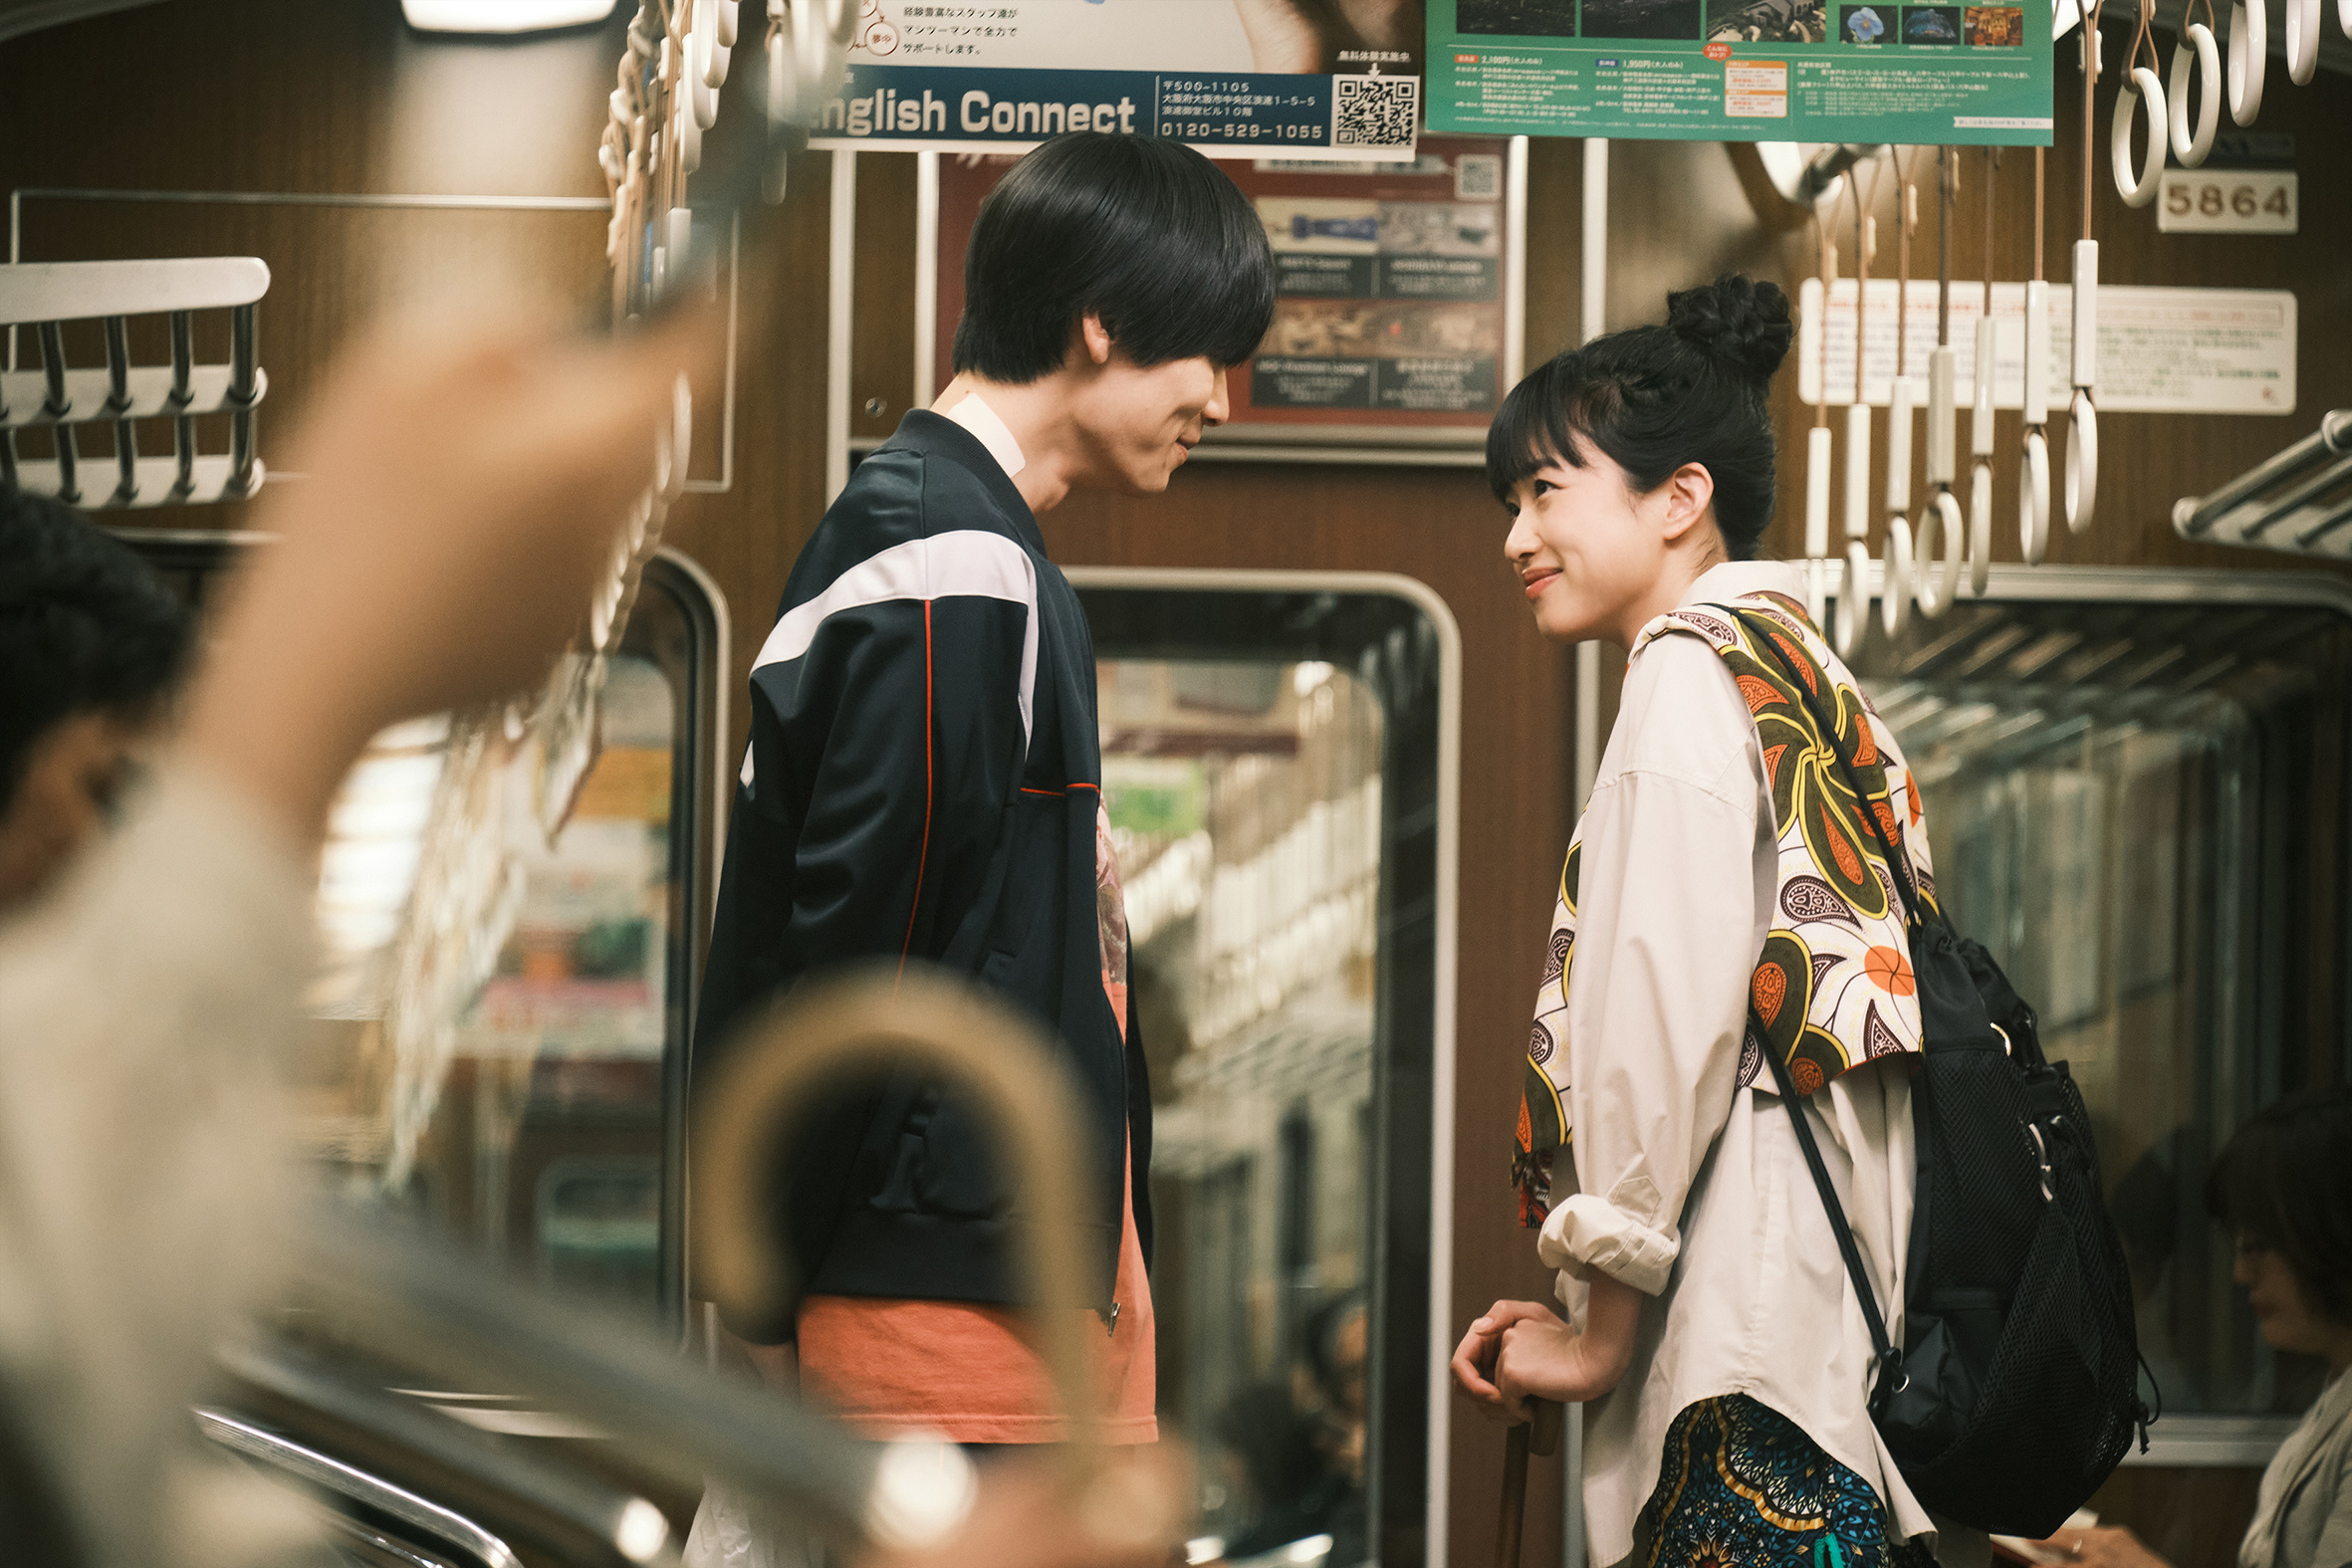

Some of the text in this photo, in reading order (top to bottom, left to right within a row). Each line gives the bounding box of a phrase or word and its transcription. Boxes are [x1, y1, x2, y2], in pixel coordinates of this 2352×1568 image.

[903, 25, 1019, 37] マンツーマンで全力で
[903, 43, 982, 55] サポートします。
[807, 89, 1136, 136] nglish Connect
[1161, 121, 1323, 139] 0120-529-1055
[2167, 184, 2289, 218] 5864
